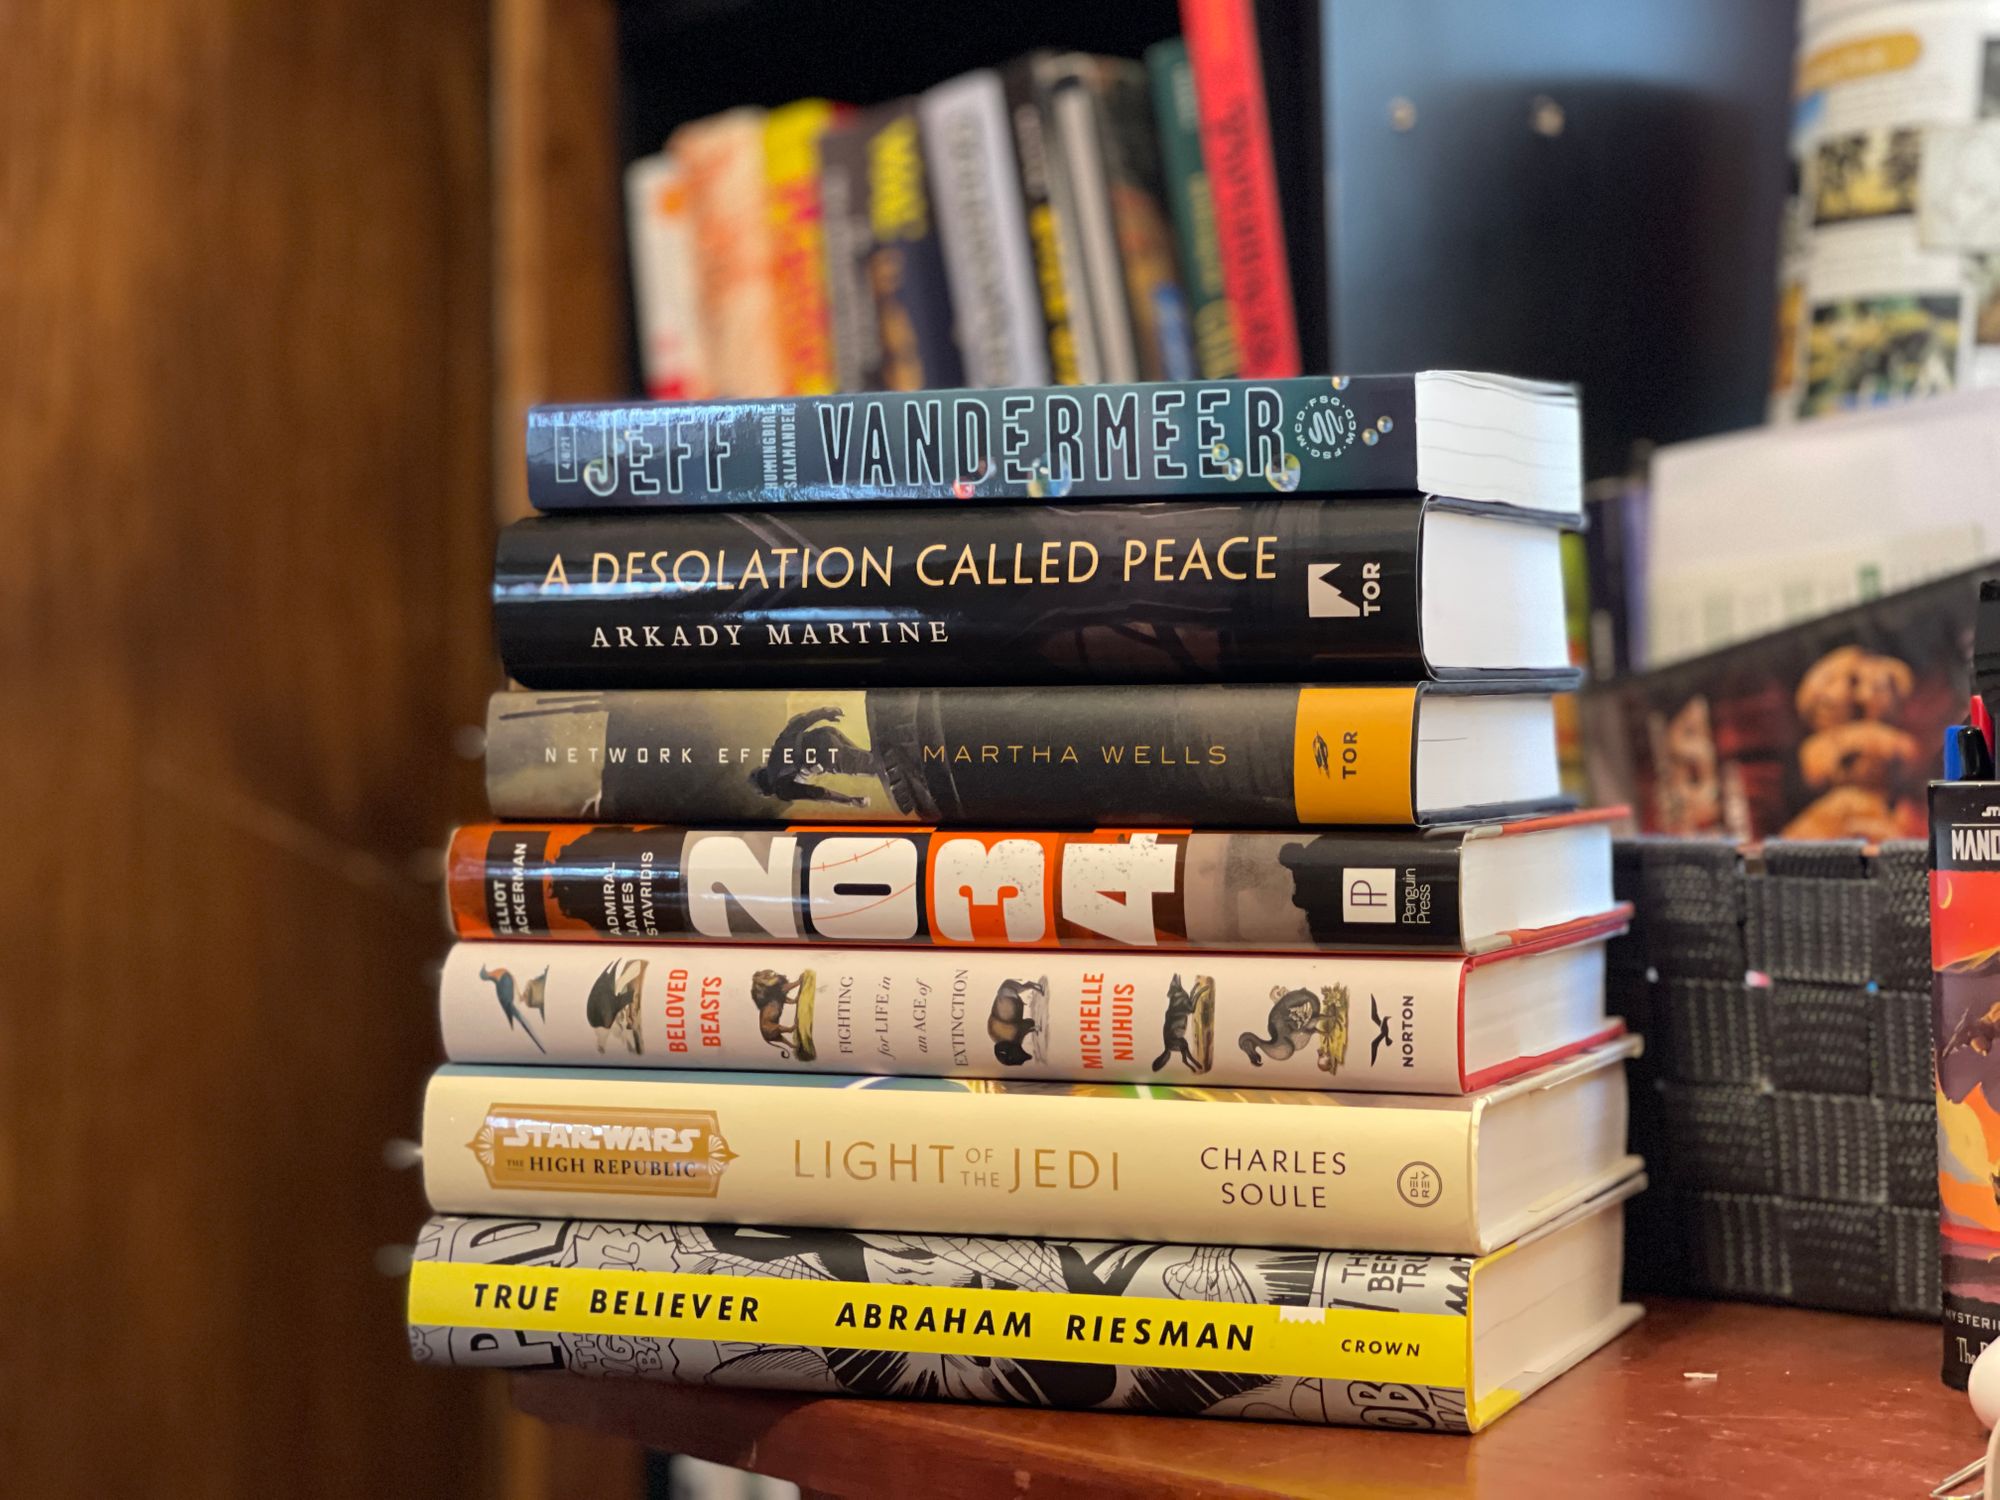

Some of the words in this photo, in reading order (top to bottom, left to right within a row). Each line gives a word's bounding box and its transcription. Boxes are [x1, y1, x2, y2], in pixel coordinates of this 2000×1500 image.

[583, 408, 735, 497] JEFF
[818, 387, 1284, 487] VANDERMEER
[540, 553, 571, 587] A
[591, 546, 894, 590] DESOLATION
[916, 539, 1099, 587] CALLED
[1124, 536, 1279, 582] PEACE
[1362, 562, 1381, 617] TOR
[591, 623, 744, 649] ARKADY
[767, 621, 949, 645] MARTINE
[545, 747, 693, 763] NETWORK
[718, 747, 840, 764] EFFECT
[922, 745, 1080, 764] MARTHA
[1101, 745, 1229, 765] WELLS
[1342, 730, 1359, 779] TOR
[493, 880, 514, 935] ELLIOT
[511, 843, 532, 935] ACKERMAN
[603, 861, 622, 936] ADMIRAL
[621, 882, 640, 936] JAMES
[640, 851, 659, 936] STAVRIDIS
[687, 832, 1178, 946] 2034
[1402, 867, 1419, 924] Penguin
[1416, 883, 1431, 924] Press
[878, 976, 892, 991] in
[916, 977, 932, 996] of
[665, 969, 689, 1053] BELOVED
[700, 976, 722, 1047] BEASTS
[838, 976, 854, 1055] FIGHTING
[875, 993, 890, 1033] LIFE
[912, 998, 927, 1033] AGE
[951, 968, 969, 1067] EXTINCTION
[1080, 972, 1104, 1070] MICHELLE
[1112, 983, 1135, 1062] NIJHUIS
[1402, 995, 1414, 1068] NORTON
[877, 1035, 896, 1061] for
[918, 1035, 928, 1054] an
[600, 1125, 701, 1153] WARS
[794, 1139, 954, 1184] LIGHT
[965, 1148, 995, 1164] OF
[1200, 1147, 1347, 1176] CHARLES
[507, 1159, 524, 1168] THE
[529, 1156, 585, 1173] HIGH
[593, 1159, 697, 1178] REPUBLIC
[960, 1171, 1000, 1187] THE
[1008, 1148, 1120, 1194] JEDI
[1410, 1172, 1418, 1198] DEL
[1421, 1171, 1430, 1198] REY
[1221, 1182, 1327, 1208] SOULE
[474, 1283, 560, 1311] TRUE
[590, 1290, 760, 1323] BELIEVER
[835, 1301, 1032, 1338] ABRAHAM
[1065, 1314, 1255, 1351] RIESMAN
[1341, 1338, 1421, 1357] CROWN
